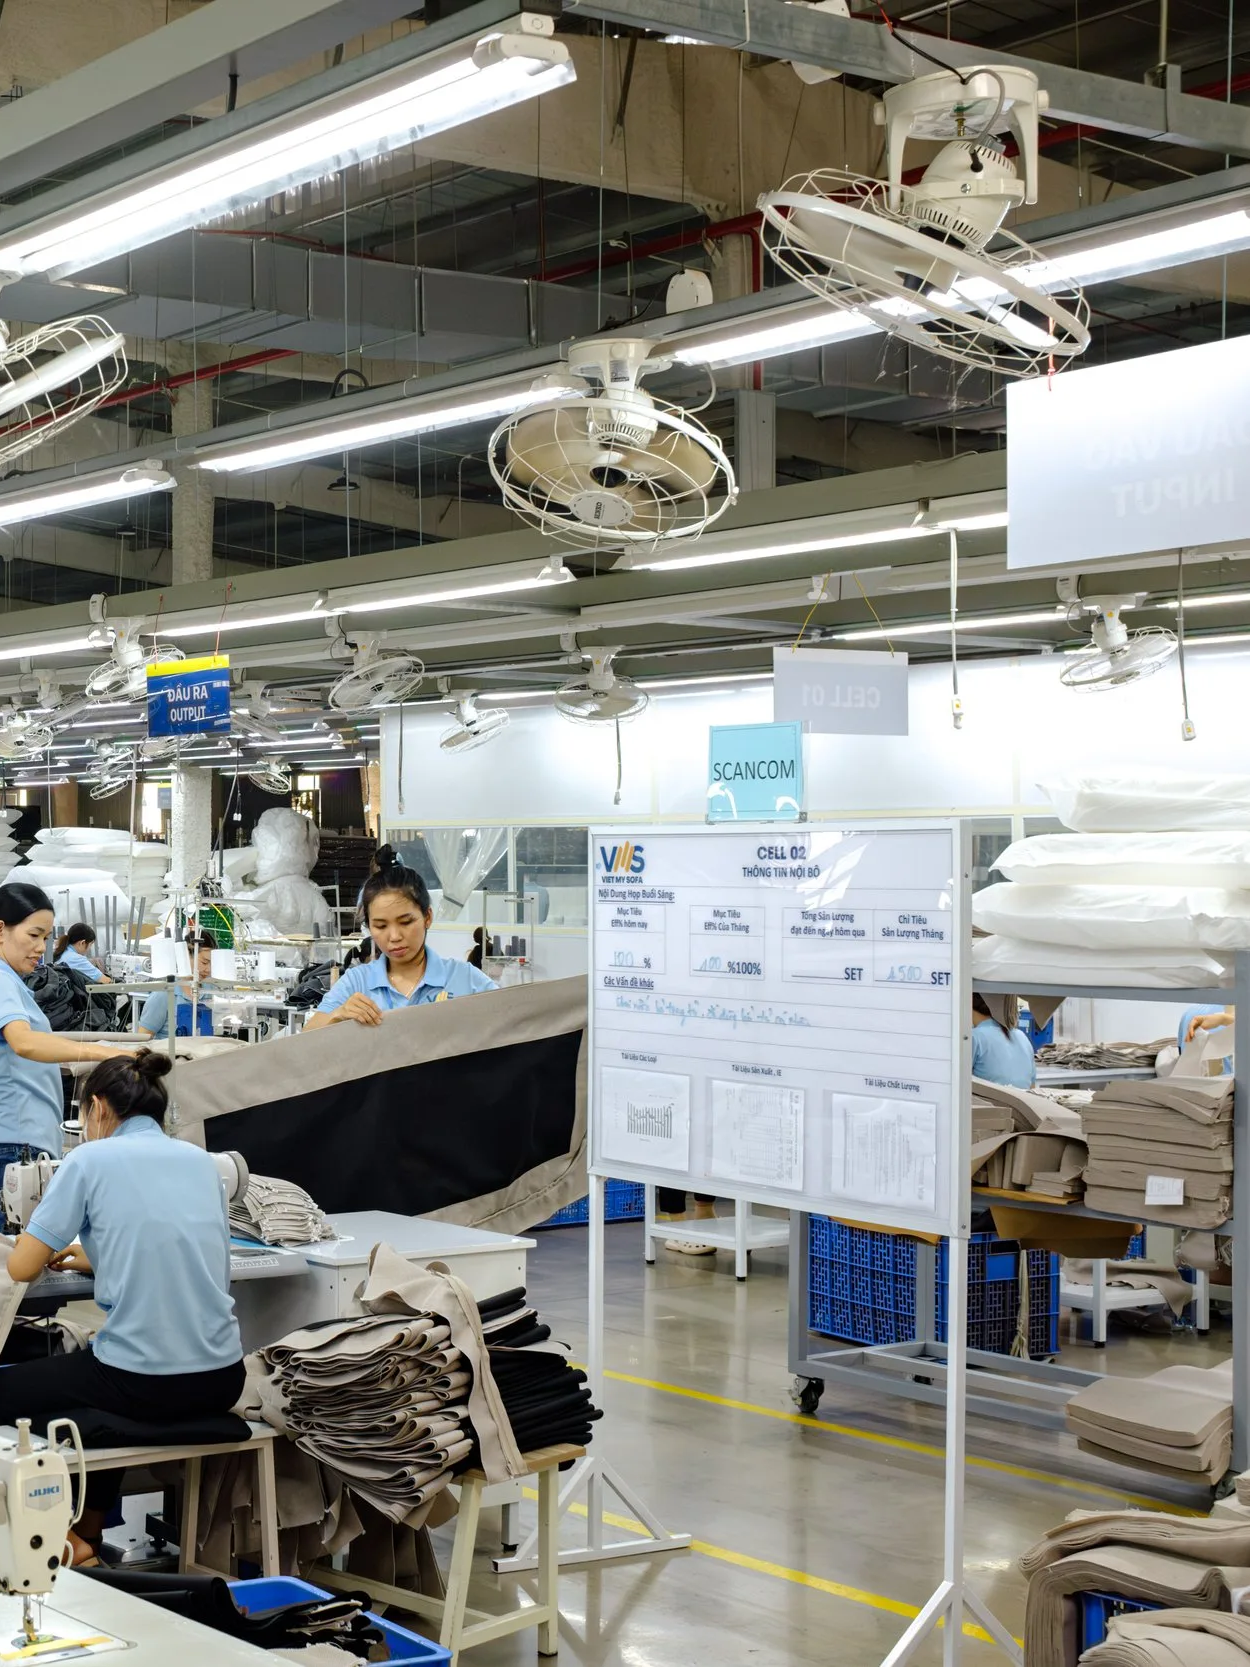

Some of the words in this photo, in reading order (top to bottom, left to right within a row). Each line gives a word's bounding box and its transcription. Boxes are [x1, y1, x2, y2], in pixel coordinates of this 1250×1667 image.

[167, 683, 190, 702] ĐẦU
[193, 685, 208, 700] RA
[170, 706, 206, 722] OUTPUT
[713, 759, 795, 782] SCANCOM
[757, 846, 787, 860] CELL
[790, 846, 806, 860] 02
[742, 864, 771, 877] THÔNG
[774, 867, 787, 877] TIN
[790, 864, 805, 880] NỘI
[602, 876, 615, 884] VIET
[615, 876, 625, 884] MY
[626, 876, 643, 884] SOFA
[611, 890, 626, 899] Dung
[911, 915, 927, 925] Tiêu
[852, 929, 865, 938] qua
[644, 957, 651, 968] %
[727, 961, 762, 975] %100%
[844, 967, 863, 981] SET
[931, 971, 951, 985] SET
[604, 976, 614, 986] Các
[639, 978, 654, 988] khác
[28, 1485, 60, 1497] JUKI
